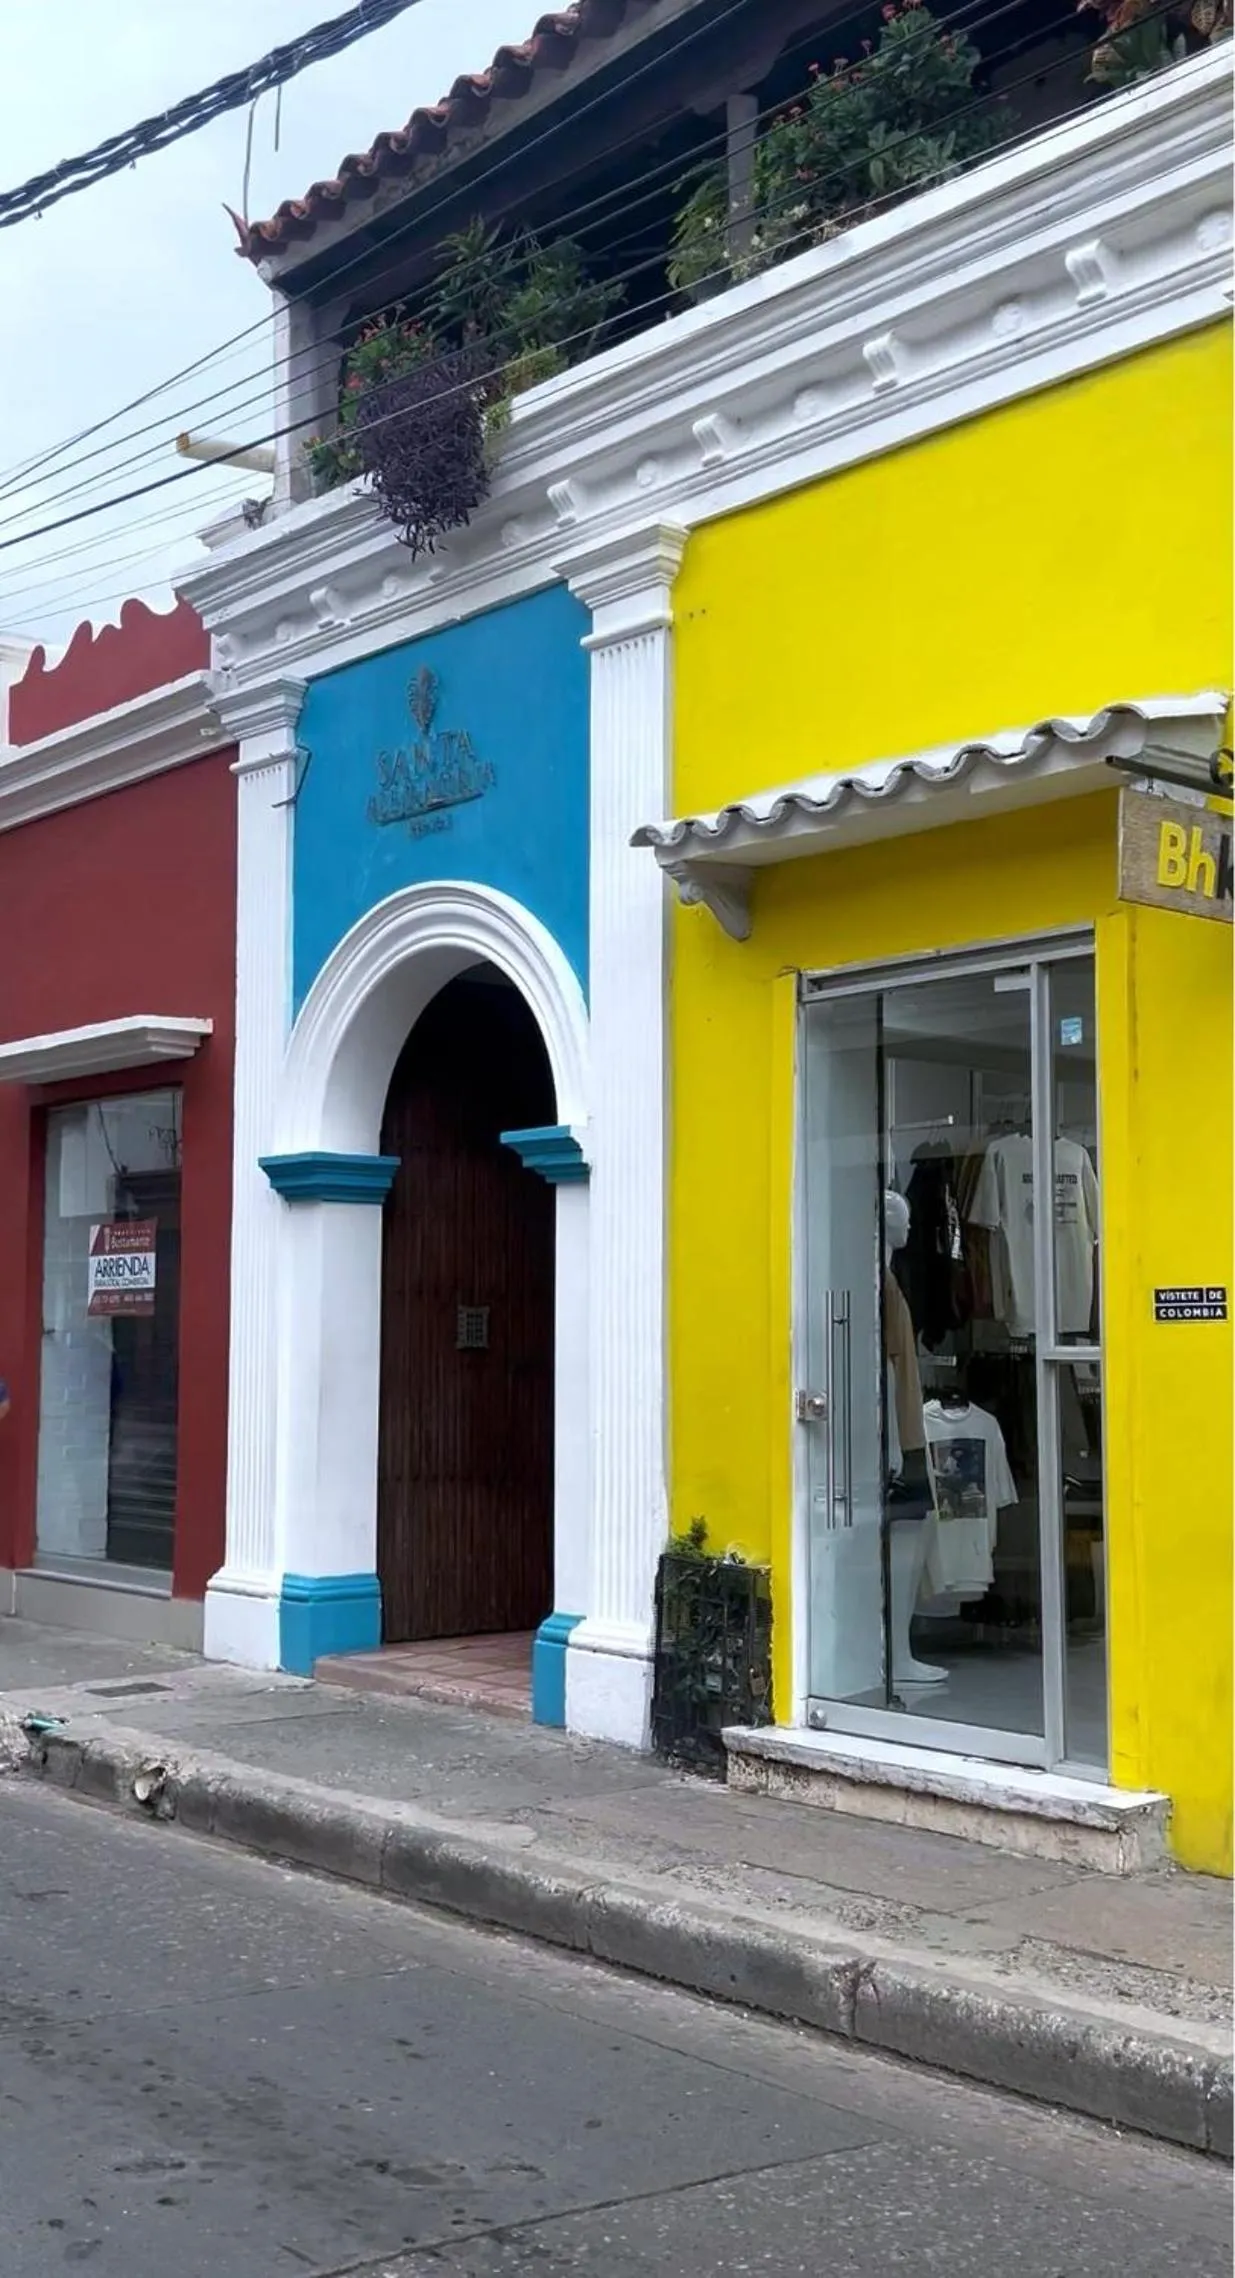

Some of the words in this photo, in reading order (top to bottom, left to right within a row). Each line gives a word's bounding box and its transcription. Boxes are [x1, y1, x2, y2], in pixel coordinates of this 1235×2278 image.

[377, 729, 477, 788] SANTA
[95, 1256, 151, 1277] ARRIENDA
[1208, 1290, 1223, 1300] DE
[1159, 1307, 1223, 1318] COLOMBIA
